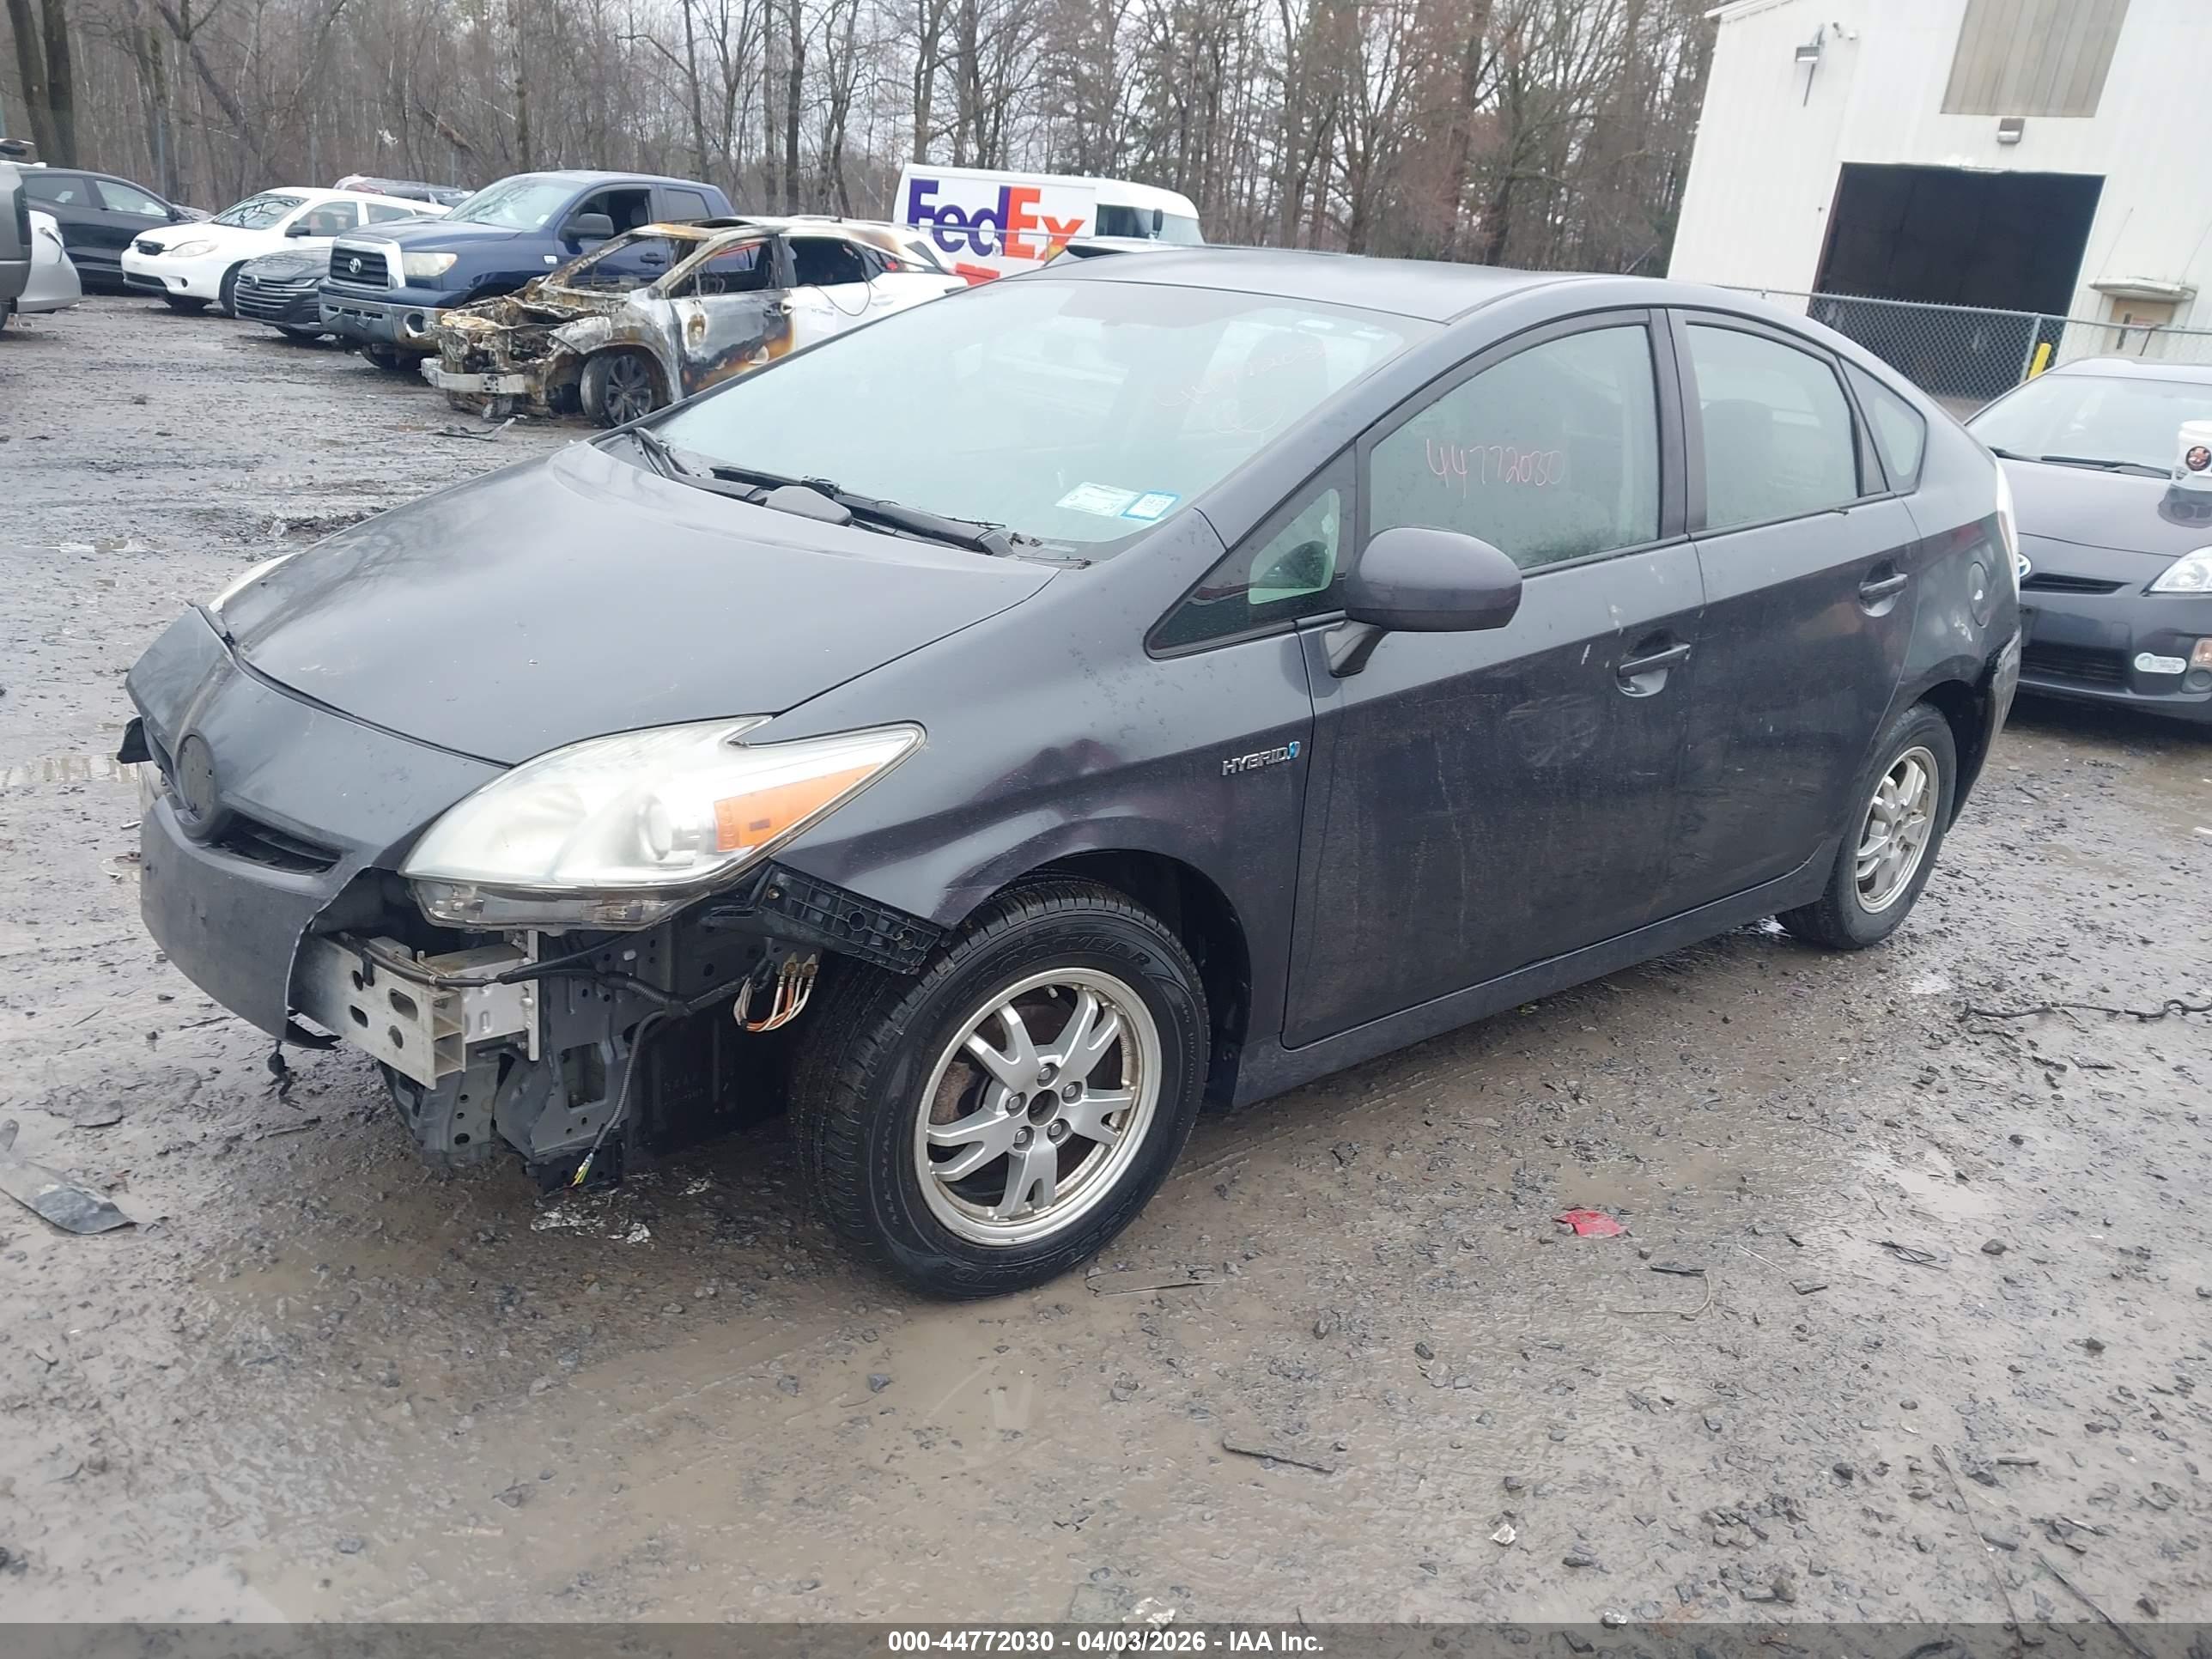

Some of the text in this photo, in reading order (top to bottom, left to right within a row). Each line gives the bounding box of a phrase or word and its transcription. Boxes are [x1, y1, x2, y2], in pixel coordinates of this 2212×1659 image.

[908, 178, 1085, 261] FedEx
[1425, 438, 1565, 498] 44772030
[1222, 746, 1288, 776] HYBRID
